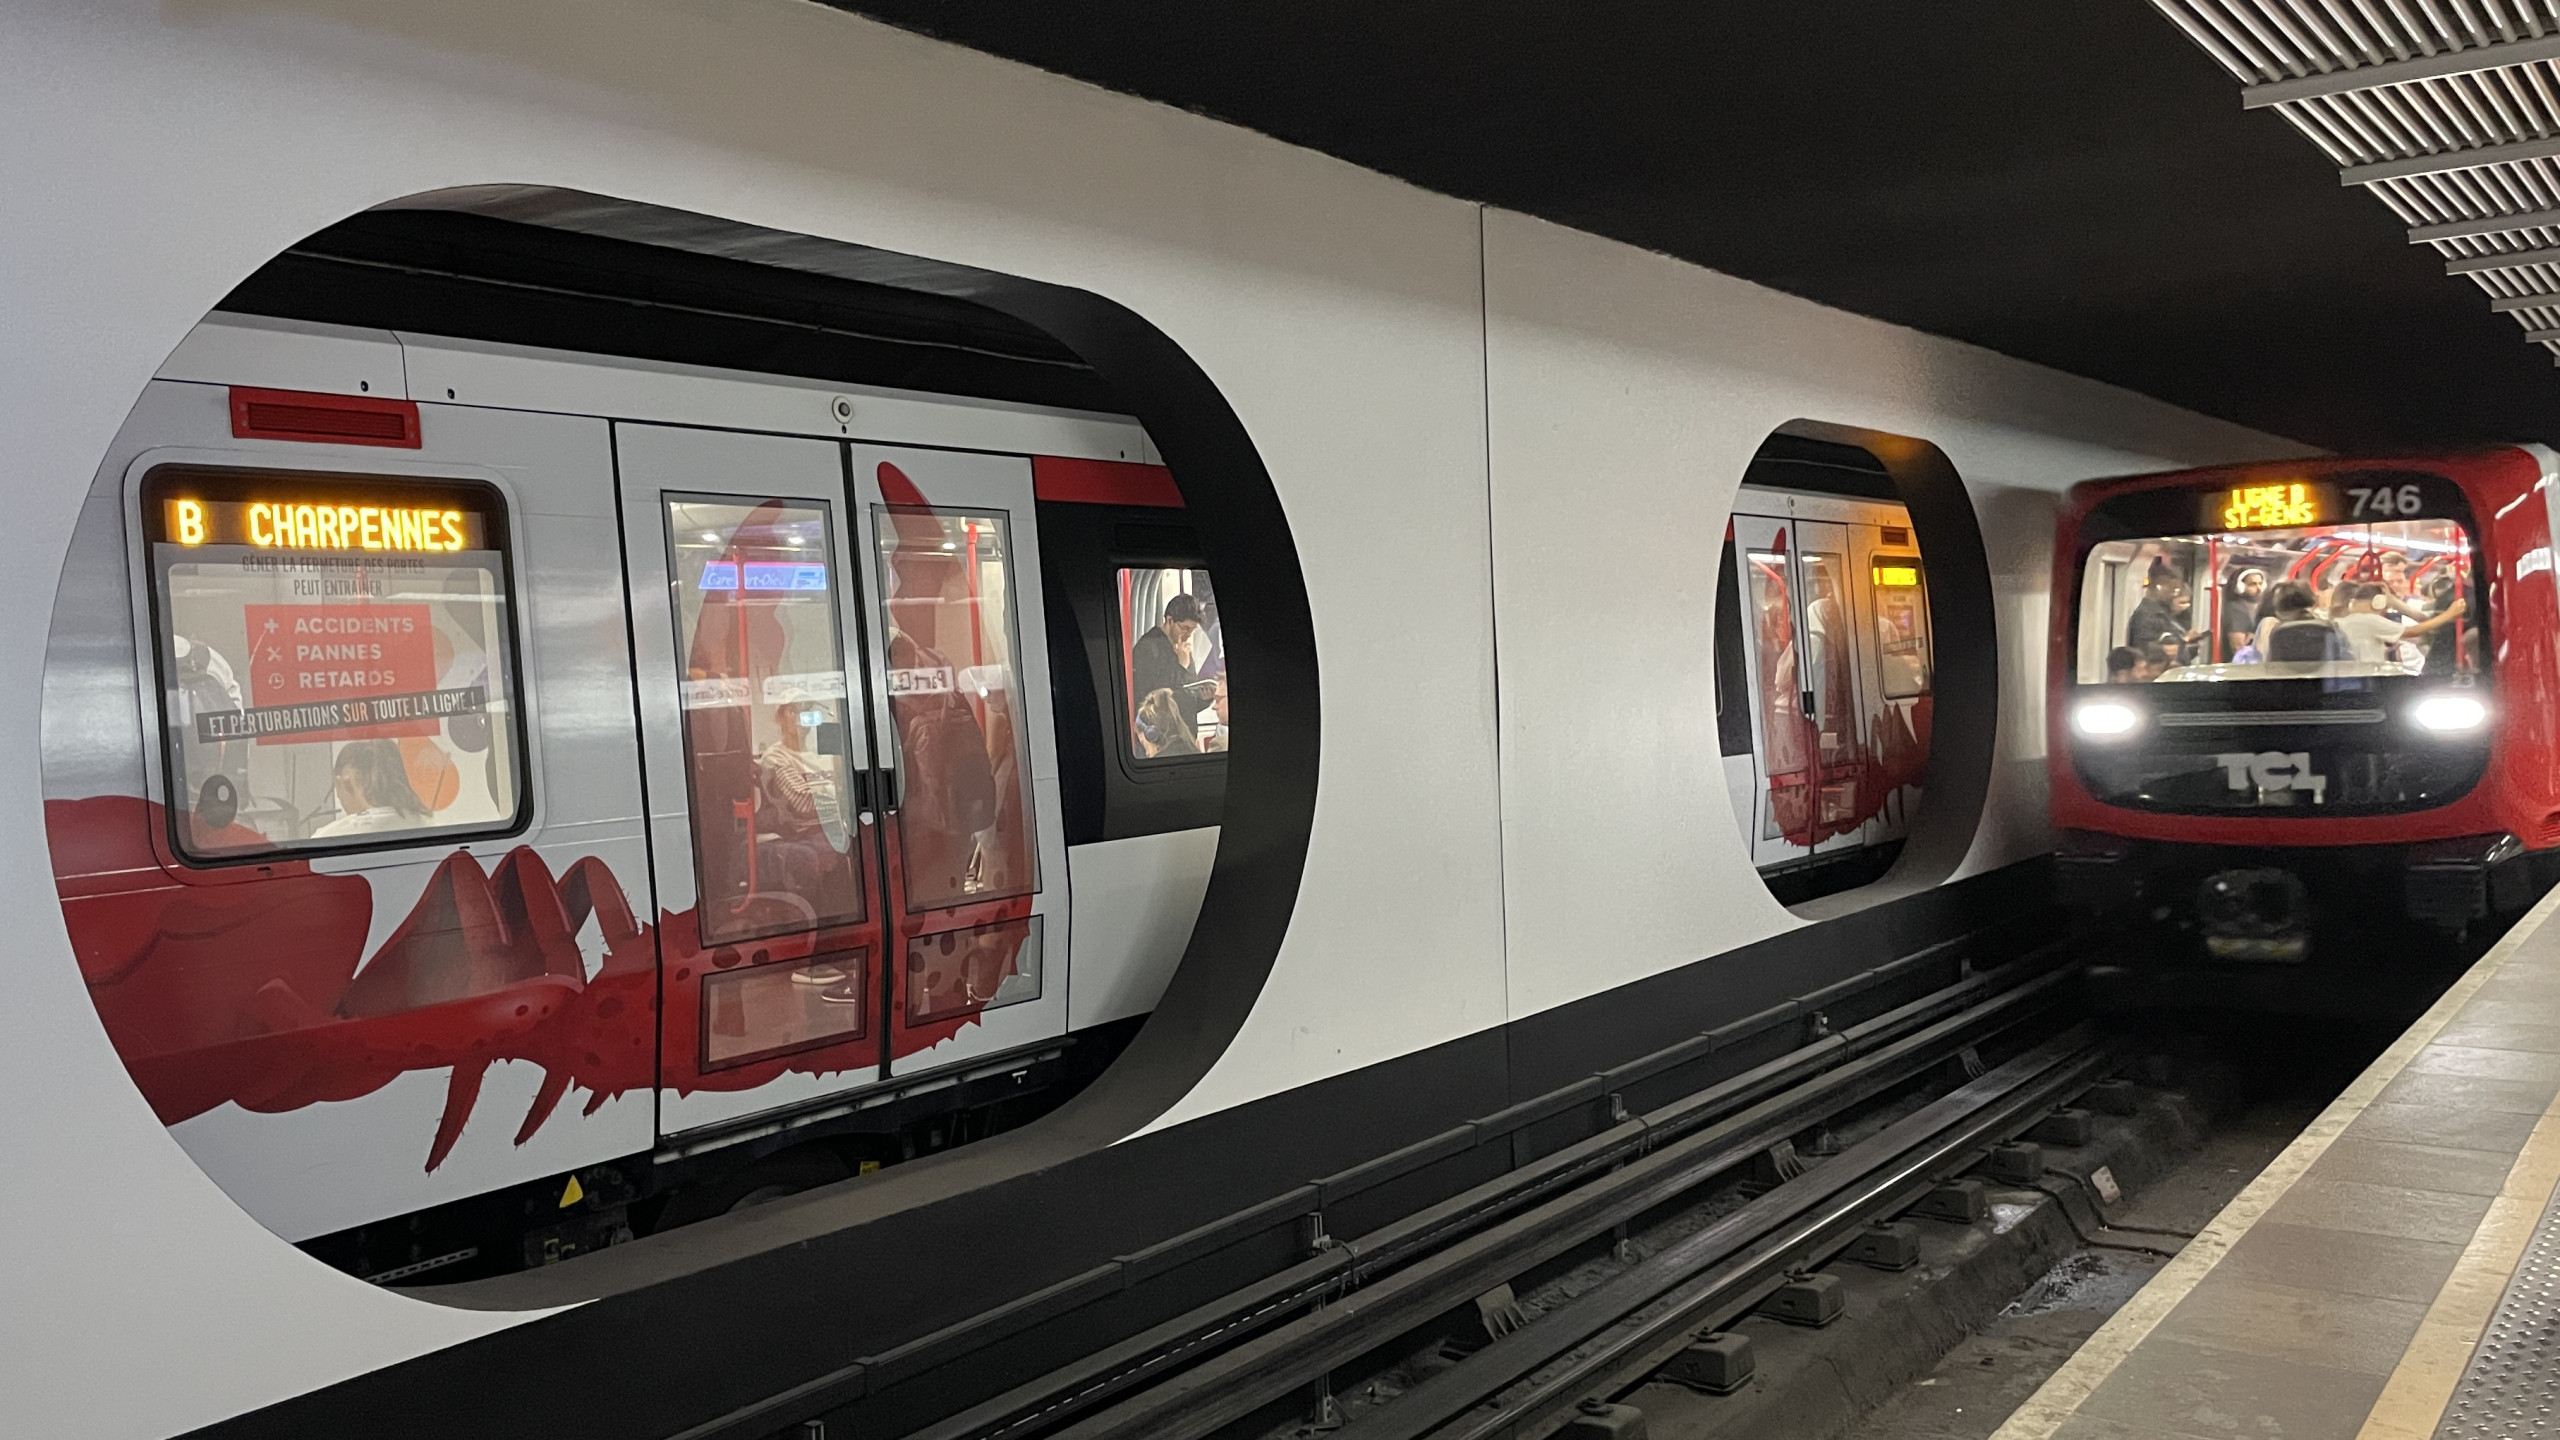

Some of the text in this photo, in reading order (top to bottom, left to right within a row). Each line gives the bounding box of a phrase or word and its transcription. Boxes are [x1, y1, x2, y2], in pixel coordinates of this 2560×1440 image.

[2347, 484, 2422, 518] 746
[177, 500, 464, 551] B CHARPENNES
[282, 556, 297, 573] LA
[300, 556, 361, 574] FERMETURE
[364, 557, 385, 574] DES
[387, 557, 426, 575] PORTES
[293, 579, 321, 597] PEUT
[706, 572, 734, 587] Gare
[294, 616, 415, 635] ACCIDENTS
[296, 643, 383, 662] PANNES
[298, 670, 397, 689] RETARDS
[208, 715, 226, 738] ET
[229, 704, 340, 735] PERTURBATIONS
[342, 701, 370, 723] SUR
[371, 697, 412, 720] TOUTE
[413, 697, 430, 717] LA
[432, 692, 468, 713] LIGNE
[2216, 751, 2327, 792] TCL
